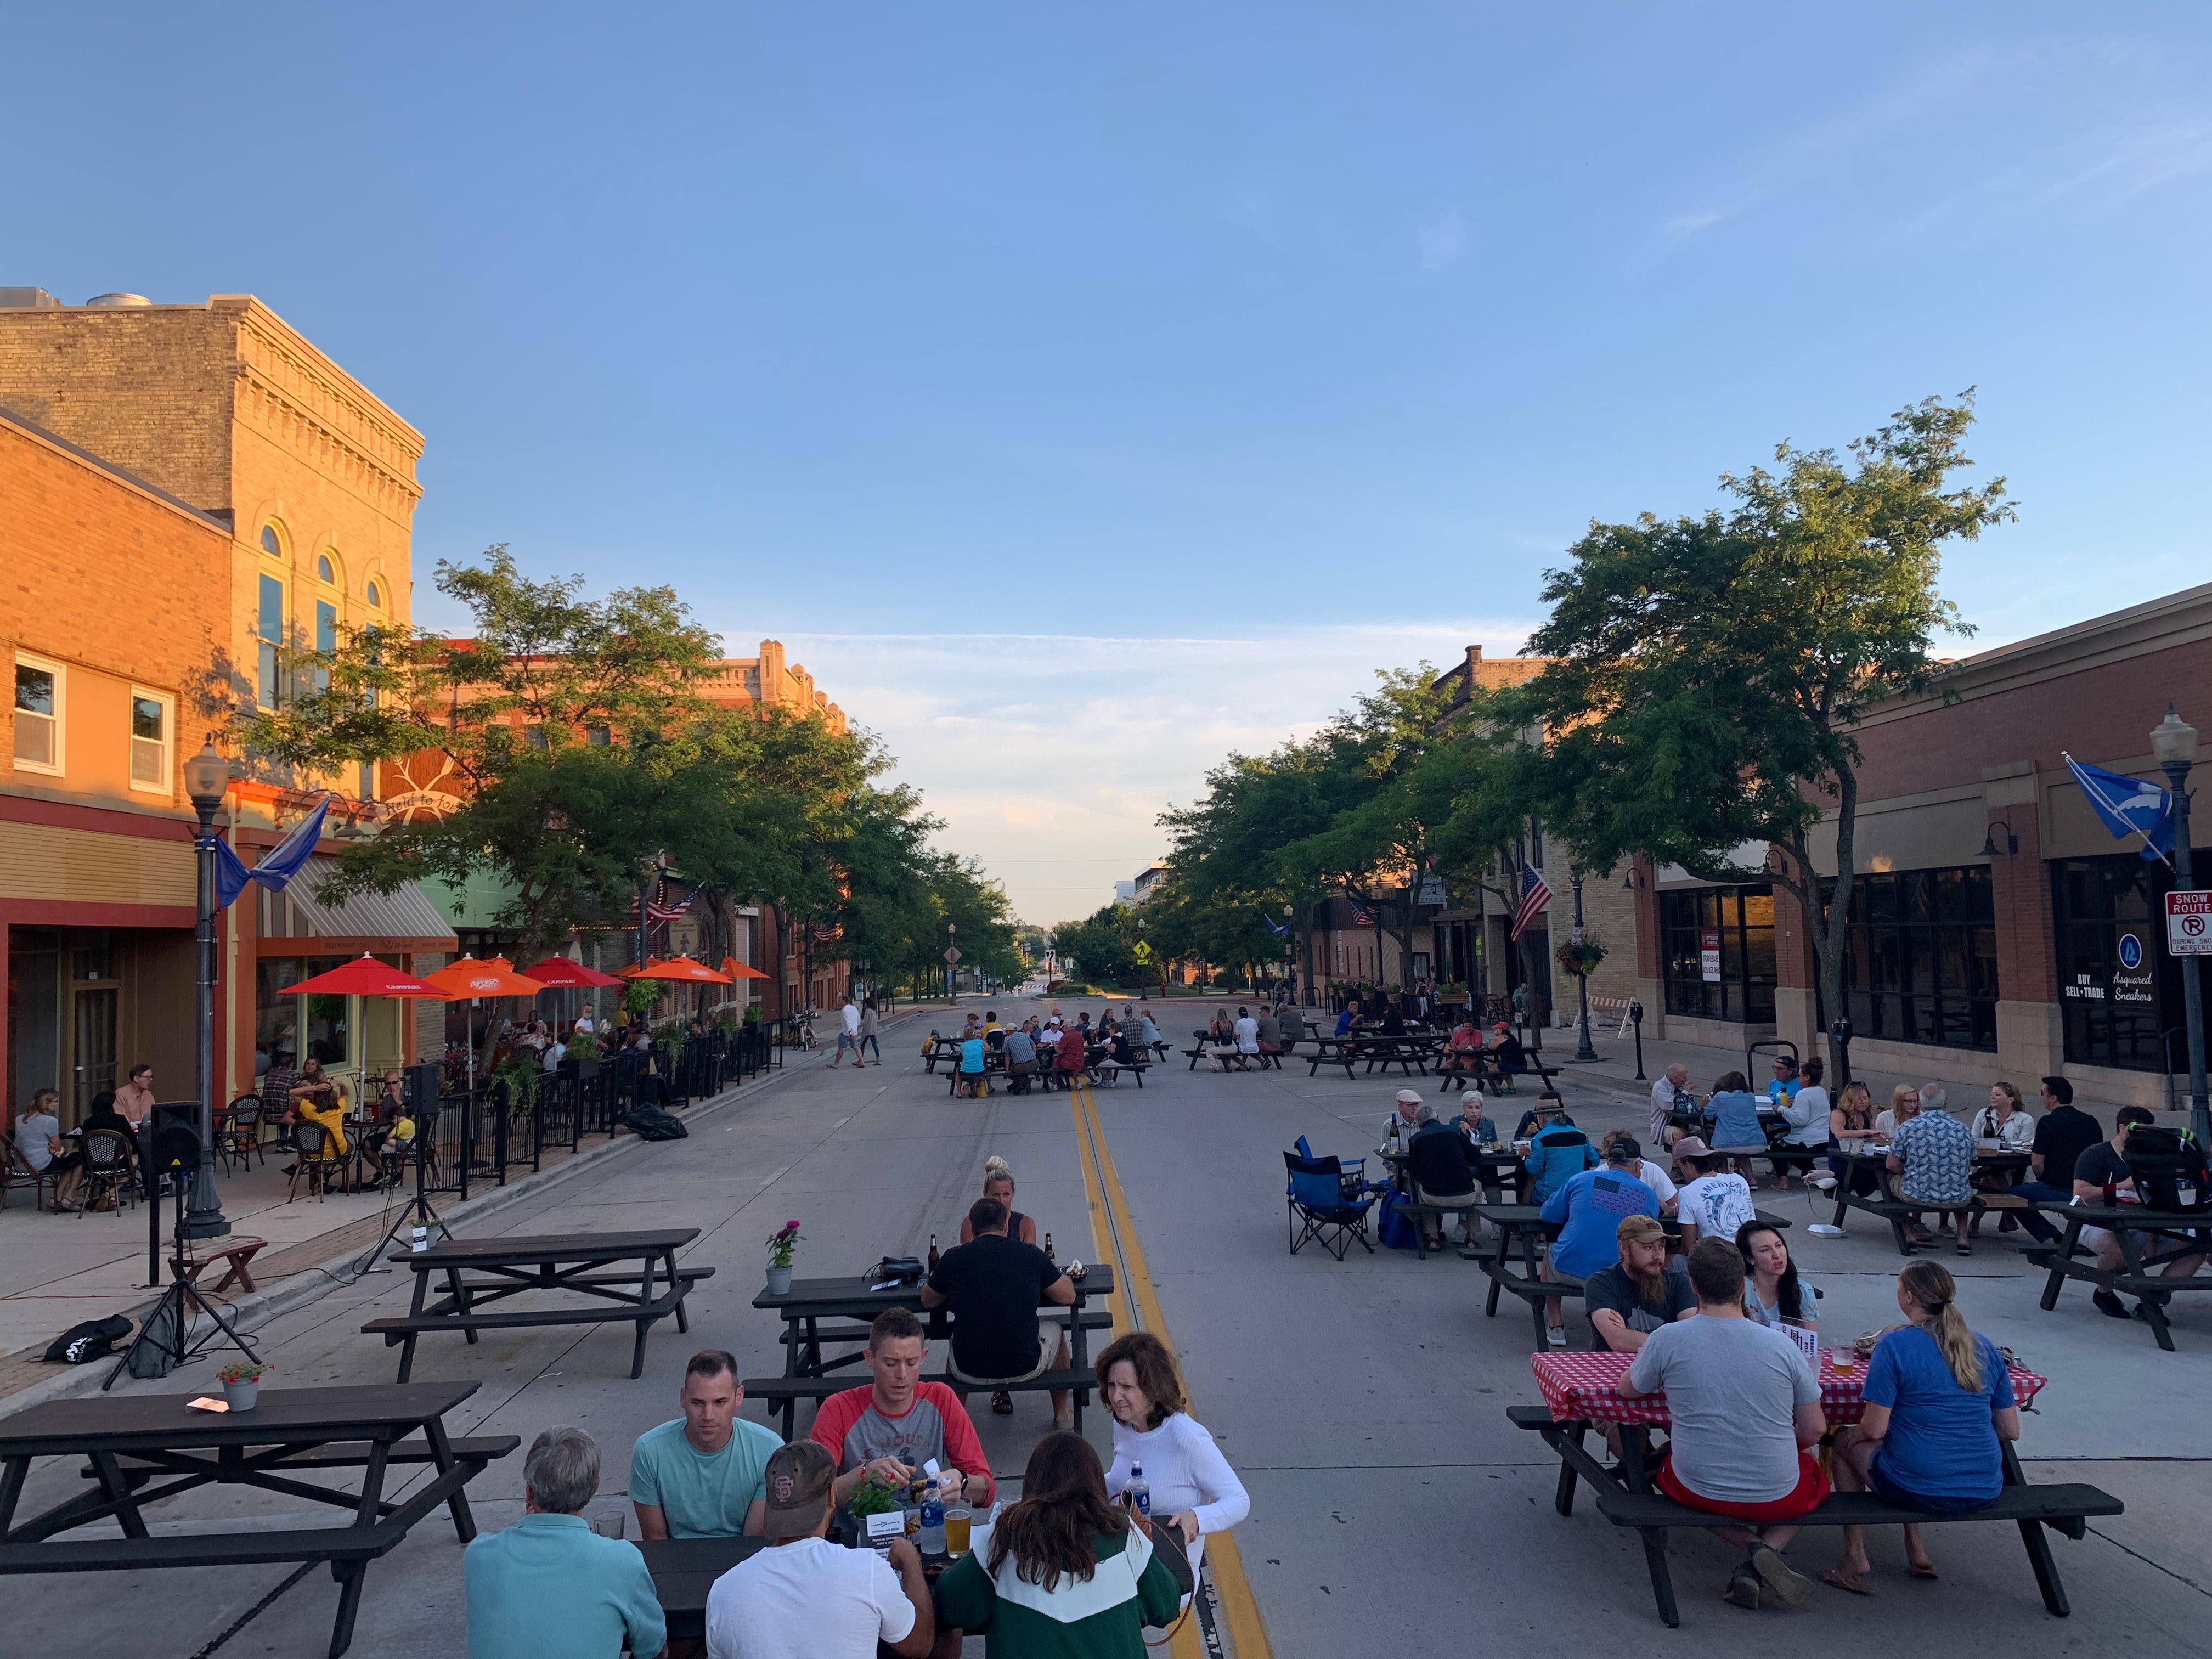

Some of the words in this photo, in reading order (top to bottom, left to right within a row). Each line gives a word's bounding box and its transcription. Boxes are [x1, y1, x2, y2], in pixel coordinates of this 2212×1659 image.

[420, 794, 433, 805] to
[437, 794, 459, 811] for
[2176, 894, 2208, 904] SNOW
[2173, 904, 2212, 913] ROUTE
[2078, 974, 2090, 985] BUY
[2113, 972, 2152, 987] Asquared
[2115, 988, 2152, 1001] Sneakers
